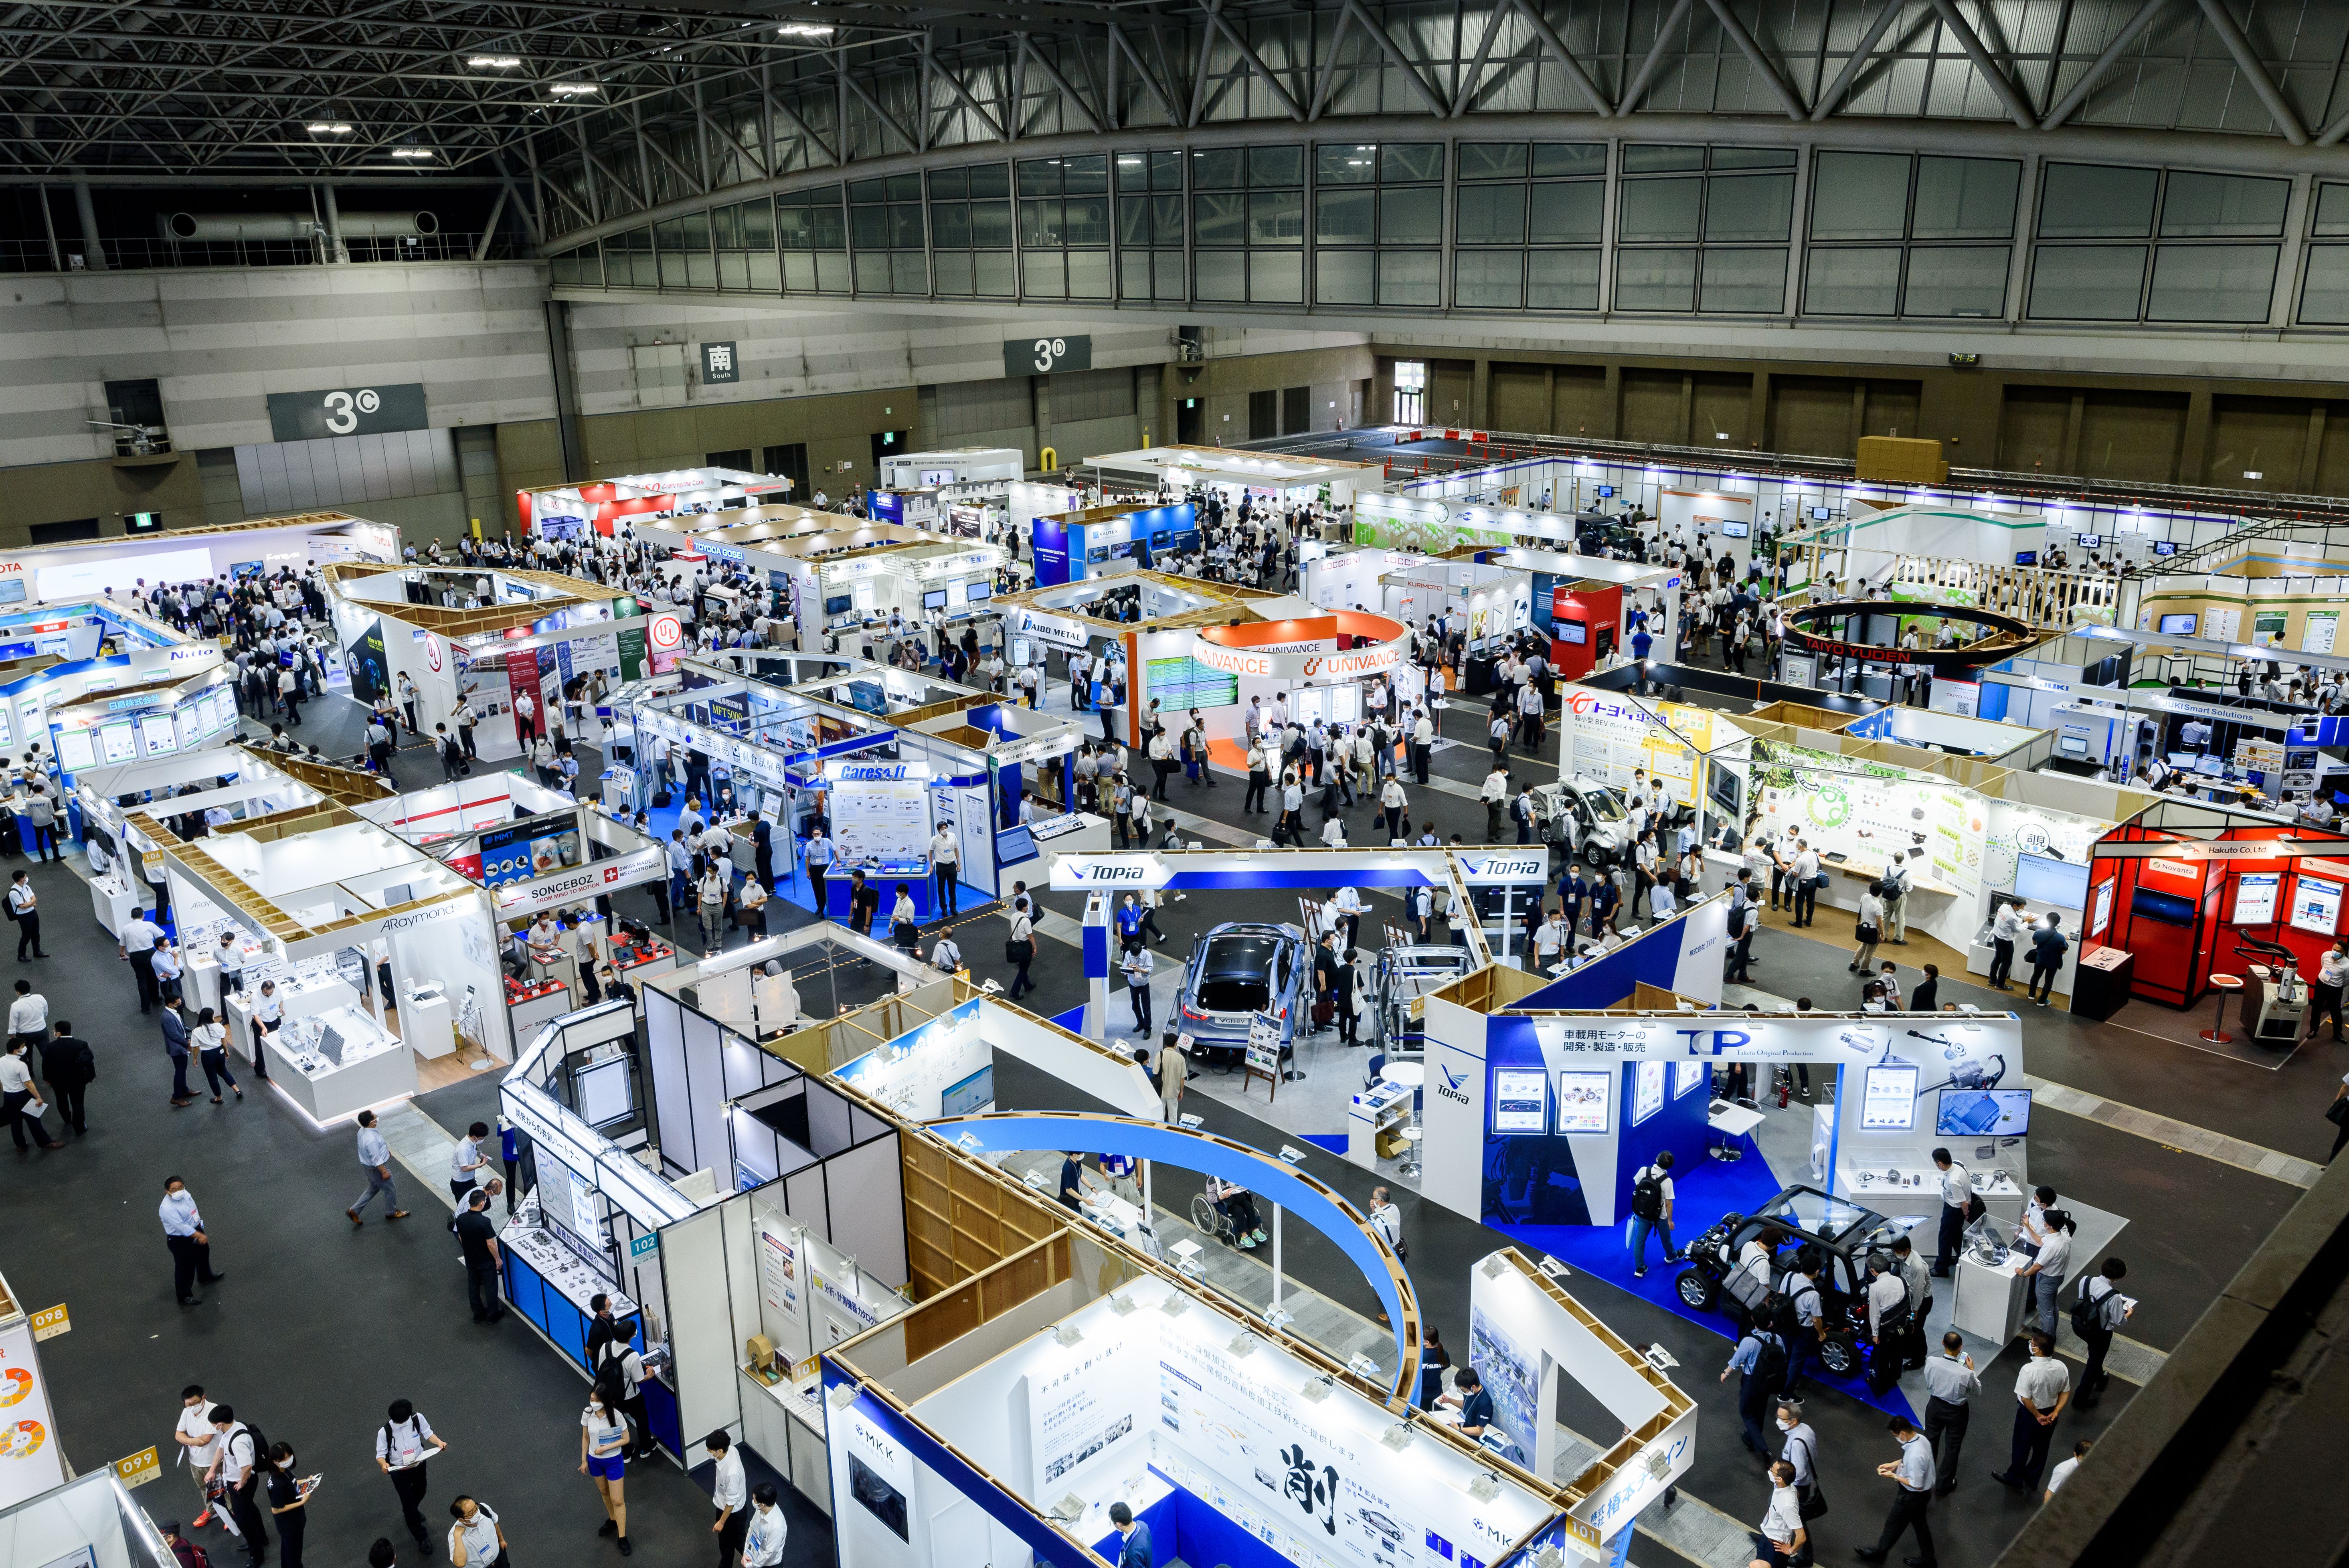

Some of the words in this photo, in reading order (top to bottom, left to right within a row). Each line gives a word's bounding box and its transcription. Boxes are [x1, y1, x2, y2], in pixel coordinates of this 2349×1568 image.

[708, 346, 731, 371] 南
[374, 536, 392, 548] TOYOTA
[694, 542, 720, 555] TOYODA
[721, 547, 744, 560] GOSEI
[1321, 556, 1360, 571] LOCCIONI
[1408, 581, 1442, 591] KURIMOTO
[660, 624, 675, 639] UL
[1053, 628, 1081, 641] METAL
[171, 649, 213, 661] Nitto
[427, 641, 438, 665] UL
[1268, 643, 1320, 653] UNIVANCE
[1805, 637, 1844, 655] TAIYO
[1848, 647, 1910, 662] YUDEN
[1197, 644, 1269, 675] UNIVANCE
[1328, 649, 1399, 673] UNIVANCE
[2039, 682, 2069, 691] JUKI
[109, 694, 160, 711] 日昌株式会社
[2163, 700, 2182, 710] JUKI
[2184, 704, 2210, 714] Smart
[2211, 708, 2254, 721] Solutions
[619, 712, 630, 720] Rtec
[1575, 715, 1593, 723] 超小型
[1595, 718, 1608, 727] BEV
[697, 732, 730, 757] 三洋貿易
[741, 750, 783, 776] 腐食試験機
[1777, 750, 1815, 762] Circular
[1821, 759, 1853, 770] Econom
[1942, 796, 1961, 808] TAB-BIO
[494, 831, 514, 842] MMT
[1938, 828, 1958, 840] TAB-PULP
[145, 853, 160, 861] 106
[620, 862, 661, 878] MECHATRONICS
[1935, 860, 1954, 873] TABCNF
[2162, 864, 2193, 875] Novanta
[531, 874, 593, 899] SONCEBOZ
[536, 896, 552, 904] FROM
[552, 892, 567, 901] MIND
[577, 883, 600, 894] MOTION
[380, 905, 454, 933] ARaymond
[1413, 1001, 1424, 1010] 121
[1563, 1030, 1646, 1040] 車載用モーターの
[1563, 1042, 1646, 1052] 開発・製造・販売
[515, 1107, 581, 1162] 開発からの共創パートナー
[635, 1237, 655, 1252] 102
[35, 1309, 63, 1327] 098
[42, 1324, 62, 1333] PARTS
[797, 1361, 815, 1378] 101
[1485, 1370, 1519, 1404] モビリティの
[866, 1430, 894, 1463] MKK
[123, 1453, 152, 1473] 099
[131, 1469, 151, 1480] PARTS
[1606, 1435, 1688, 1519] 椿本チイン
[1279, 1443, 1339, 1537] 削
[1345, 1477, 1390, 1509] 自動車部品領域
[1571, 1521, 1596, 1543] 101
[1461, 1551, 1469, 1560] 02
